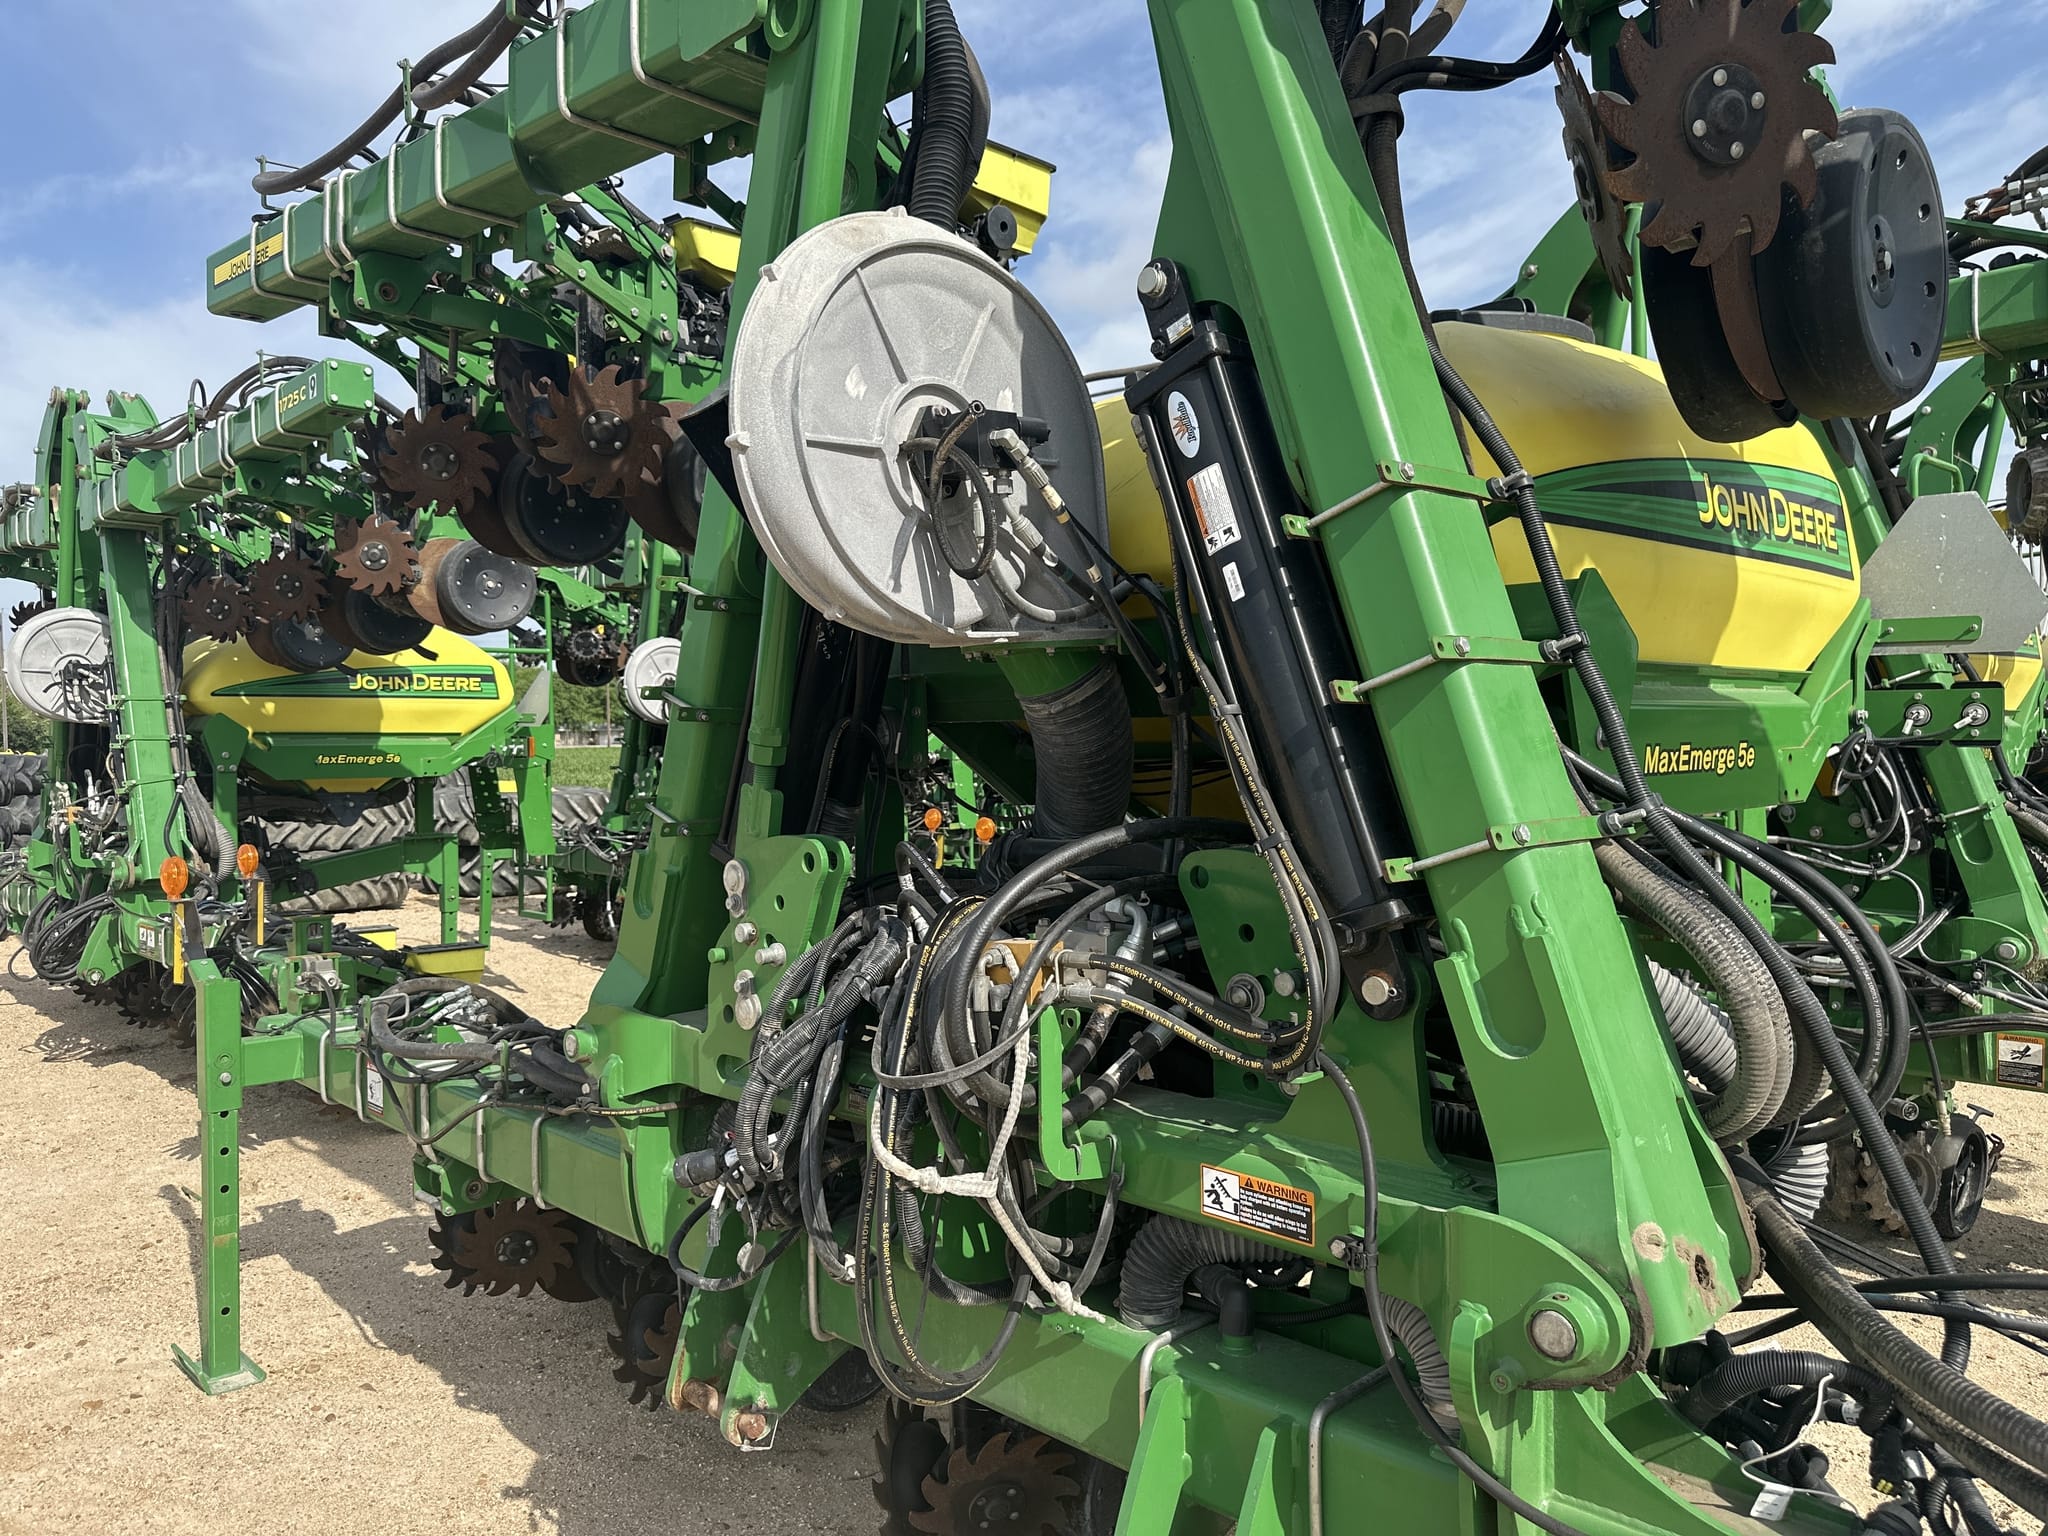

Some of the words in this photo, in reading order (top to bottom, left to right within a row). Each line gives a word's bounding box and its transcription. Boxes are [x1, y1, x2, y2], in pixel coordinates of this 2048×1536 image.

[228, 257, 246, 278] JOHN
[247, 246, 269, 268] DERE
[1699, 472, 1770, 535] JOHN
[1768, 488, 1838, 551] DEERE
[350, 673, 409, 690] JOHN
[412, 673, 482, 692] DEERE
[386, 754, 400, 763] 5e
[1644, 743, 1736, 775] MaxEmerge
[1737, 742, 1756, 768] 5e
[1154, 980, 1162, 989] 10
[1161, 985, 1174, 997] mm
[1174, 992, 1188, 1006] (3/8)
[1194, 1006, 1205, 1016] 1W
[1144, 1008, 1173, 1029] TOUGH
[1174, 1024, 1197, 1042] COVER
[1198, 1038, 1224, 1056] 451TC-6
[1224, 1050, 1236, 1061] WP
[1236, 1057, 1250, 1067] 21.0
[1292, 1043, 1306, 1063] MSHA
[865, 1197, 872, 1209] 1W
[1256, 1180, 1308, 1203] WARNING
[861, 1213, 870, 1245] 10-4Q16
[897, 1324, 904, 1335] 1W
